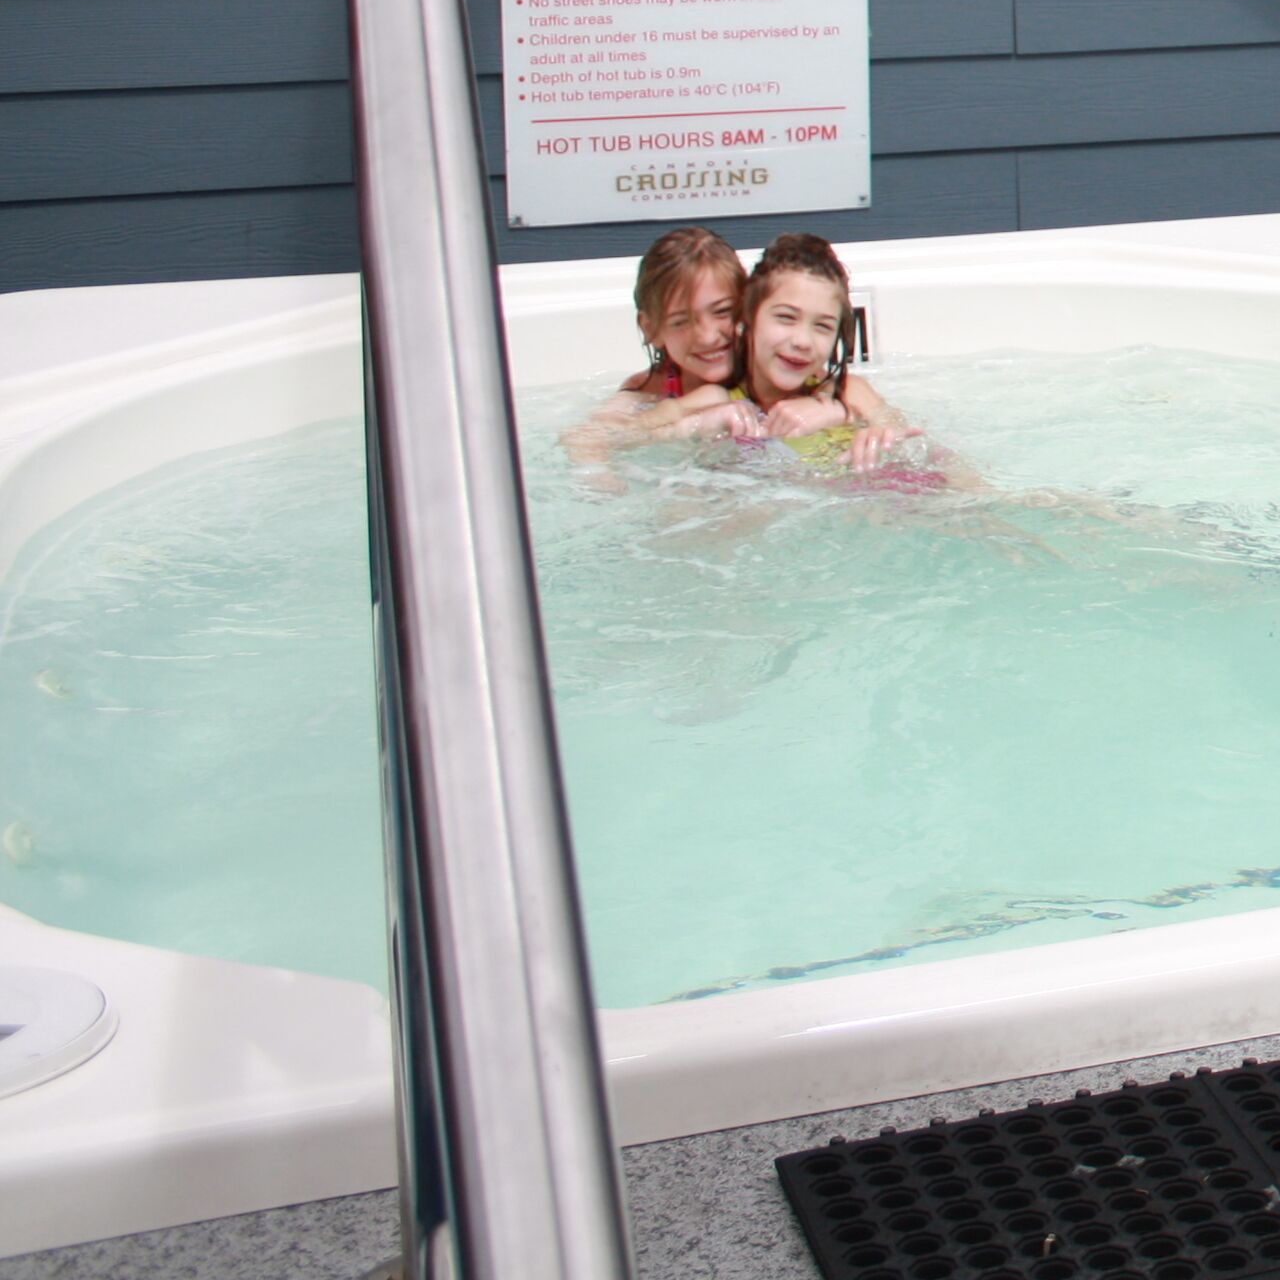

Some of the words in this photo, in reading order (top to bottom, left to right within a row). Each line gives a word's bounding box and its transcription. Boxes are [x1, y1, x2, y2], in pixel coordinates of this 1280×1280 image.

[529, 13, 569, 26] traffic
[574, 15, 613, 25] areas
[529, 31, 590, 45] Children
[595, 29, 636, 43] under
[642, 29, 658, 42] 16
[662, 27, 696, 41] must
[701, 27, 718, 40] be
[723, 24, 798, 42] supervised
[802, 23, 819, 40] by
[823, 26, 839, 36] an
[530, 51, 565, 64] adult
[570, 50, 583, 63] at
[588, 50, 604, 63] all
[608, 48, 646, 62] times
[530, 69, 573, 87] Depth
[578, 68, 592, 82] of
[596, 67, 618, 81] hot
[623, 66, 646, 80] tub
[650, 66, 662, 79] is
[666, 65, 700, 79] 0.9m
[531, 88, 556, 102] Hot
[561, 87, 584, 101] tub
[588, 84, 674, 103] temperature
[679, 84, 690, 97] is
[694, 82, 727, 96] 40°C
[732, 81, 780, 98] (104°F)
[536, 139, 581, 154] HOT
[589, 135, 631, 151] TUB
[639, 132, 714, 150] HOURS
[722, 129, 764, 146] 8AM
[786, 126, 837, 143] 10PM
[631, 159, 748, 171] CANMORE
[616, 168, 769, 192] CROSSING
[632, 189, 750, 202] CONDOMINIUM
